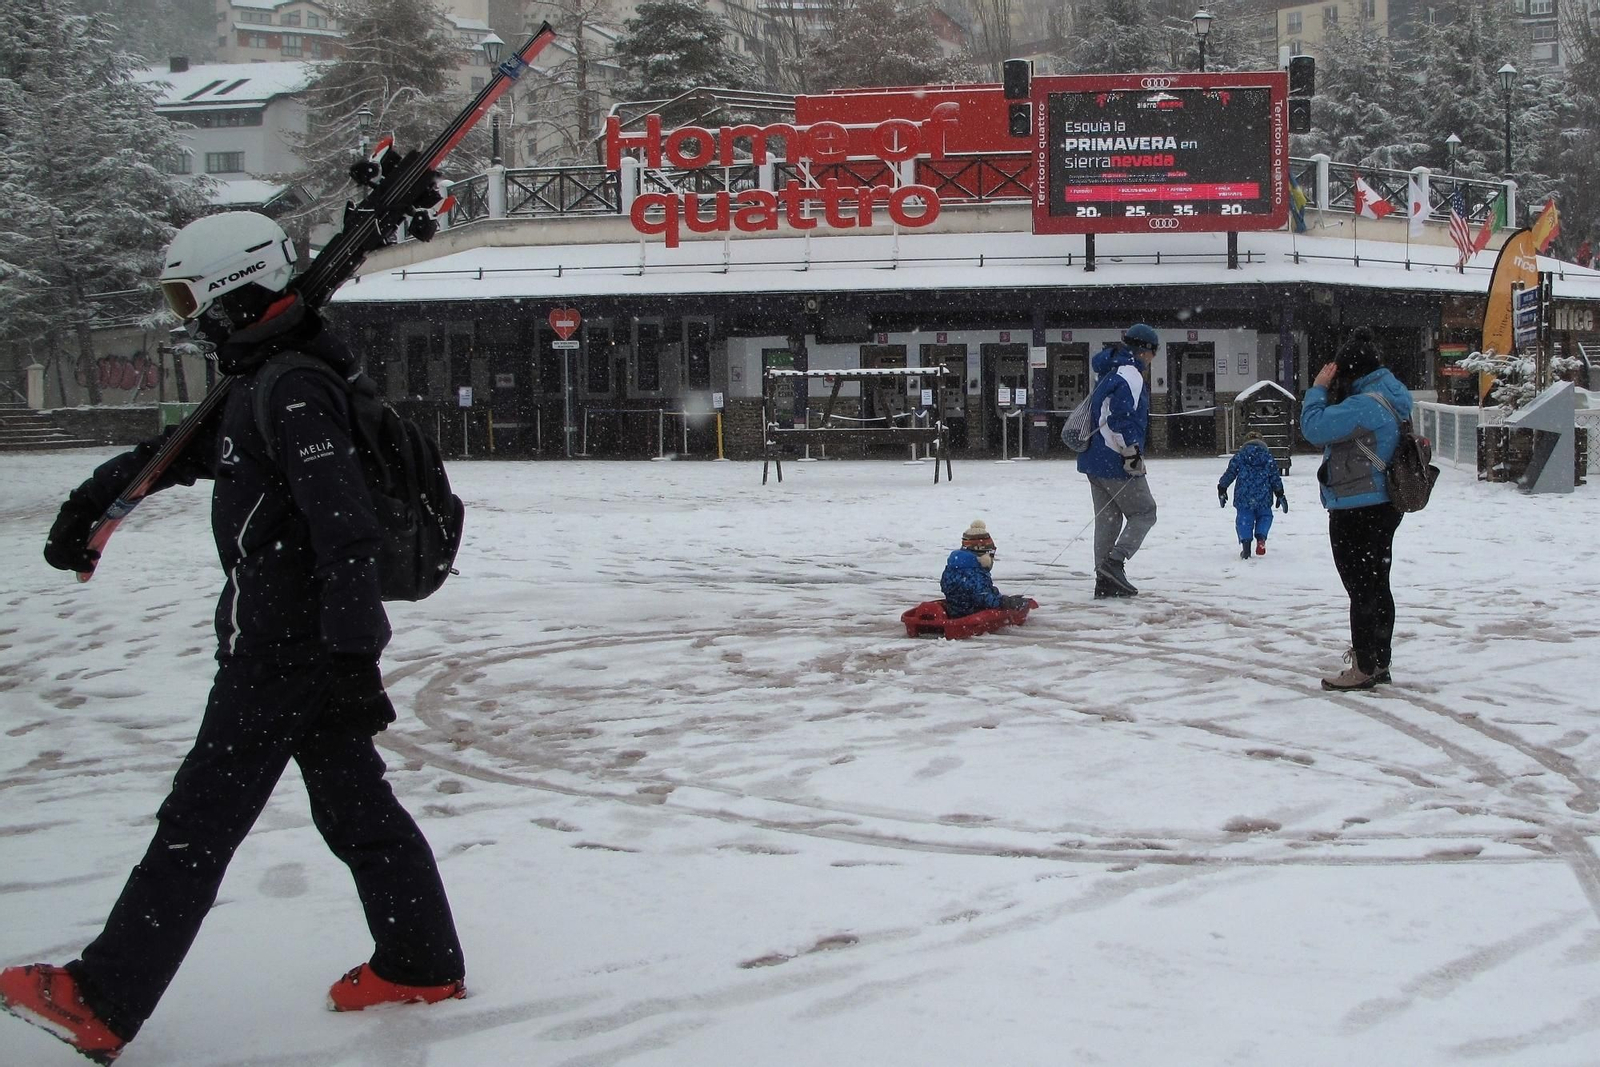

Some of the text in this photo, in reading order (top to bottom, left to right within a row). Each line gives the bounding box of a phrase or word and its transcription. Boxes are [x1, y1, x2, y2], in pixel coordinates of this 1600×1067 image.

[606, 102, 960, 171] Home of
[1065, 136, 1198, 152] PRIMAVERA en
[1114, 120, 1126, 132] la
[1037, 103, 1047, 208] Territorio quattro
[1064, 153, 1175, 169] sierranevada
[1273, 100, 1283, 205] Territorio quattro
[630, 177, 942, 249] quattro
[208, 261, 266, 292] ATOMIC
